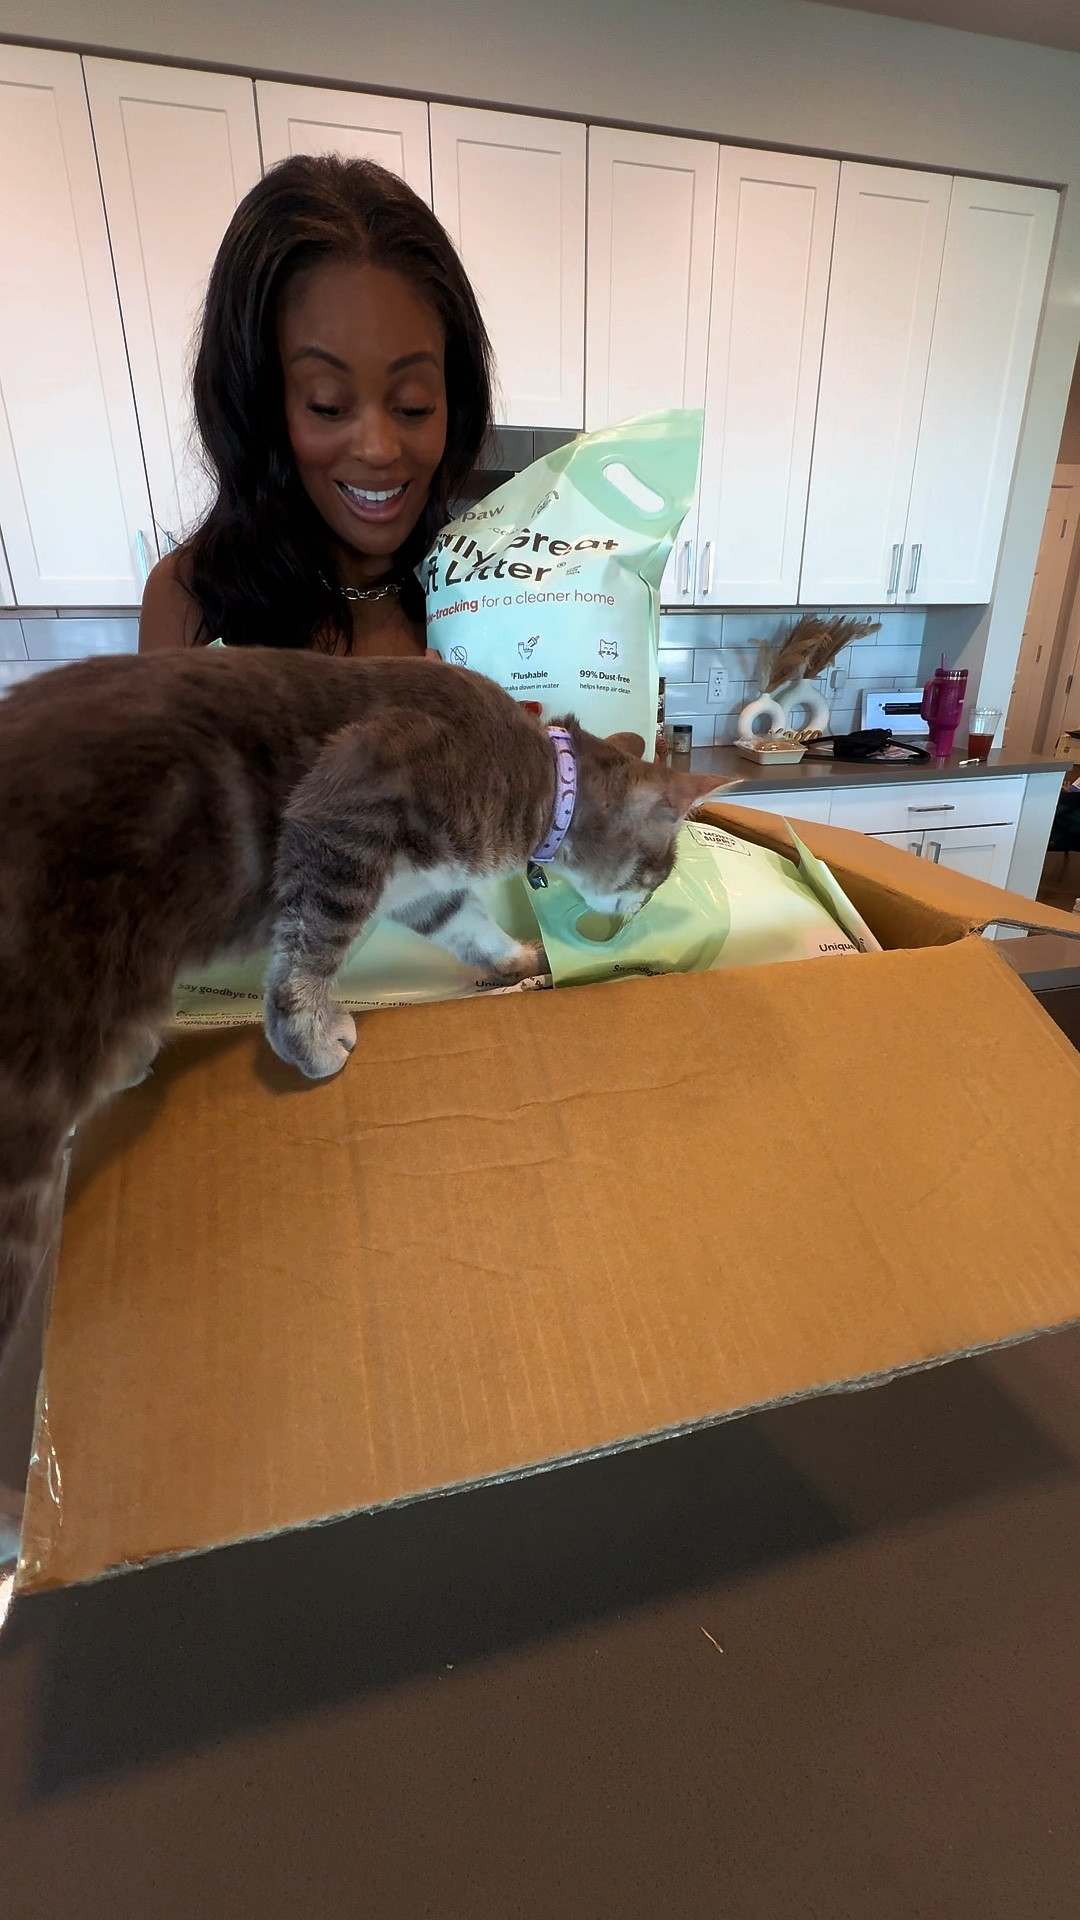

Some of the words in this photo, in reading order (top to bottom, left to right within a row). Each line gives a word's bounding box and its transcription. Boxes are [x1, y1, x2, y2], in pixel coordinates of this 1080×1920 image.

[462, 504, 504, 523] paw
[482, 595, 500, 608] for
[503, 597, 512, 606] a
[515, 591, 571, 605] cleaner
[574, 590, 615, 606] home
[579, 669, 599, 678] 99%
[579, 682, 596, 690] helps
[199, 986, 246, 999] goodbye
[247, 992, 259, 1000] to
